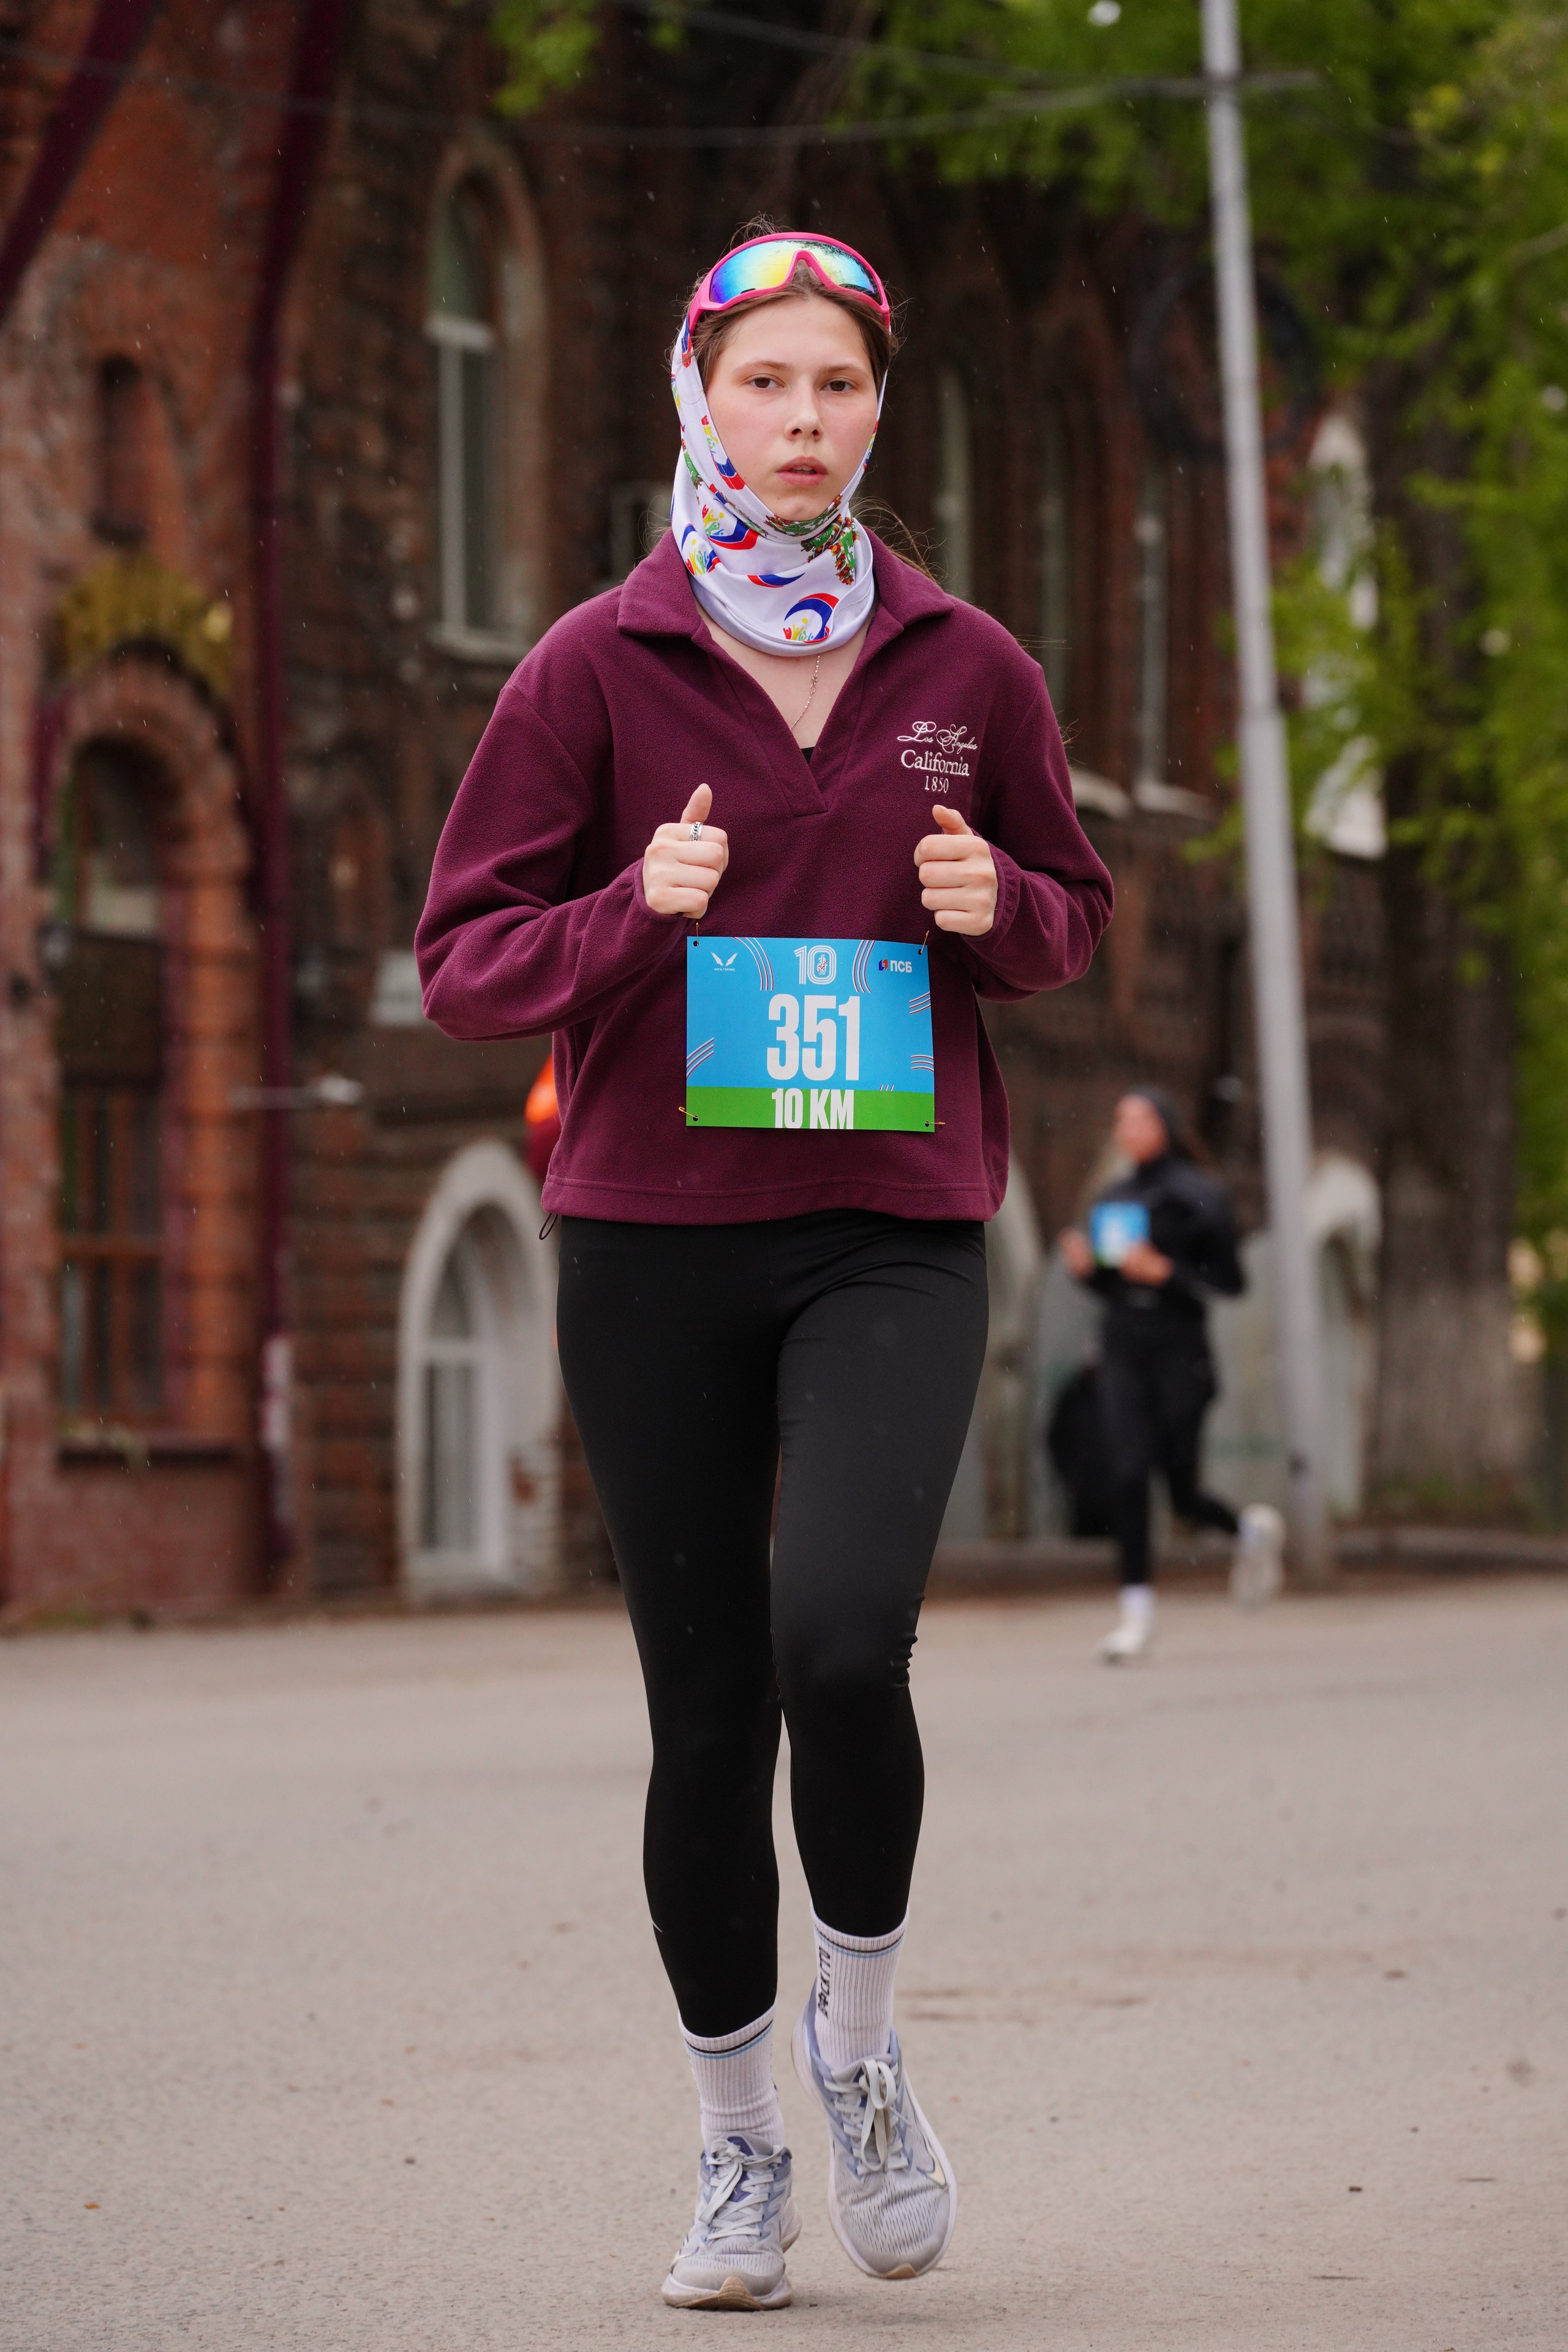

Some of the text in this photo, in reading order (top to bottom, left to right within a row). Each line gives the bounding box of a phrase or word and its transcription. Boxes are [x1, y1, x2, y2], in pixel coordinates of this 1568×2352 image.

[897, 722, 978, 754] Los Angeles
[901, 750, 970, 776] California
[924, 775, 949, 793] 1850
[794, 945, 837, 984] 10
[891, 960, 913, 973] ПСБ
[767, 993, 860, 1081] 351
[772, 1088, 803, 1129] 10
